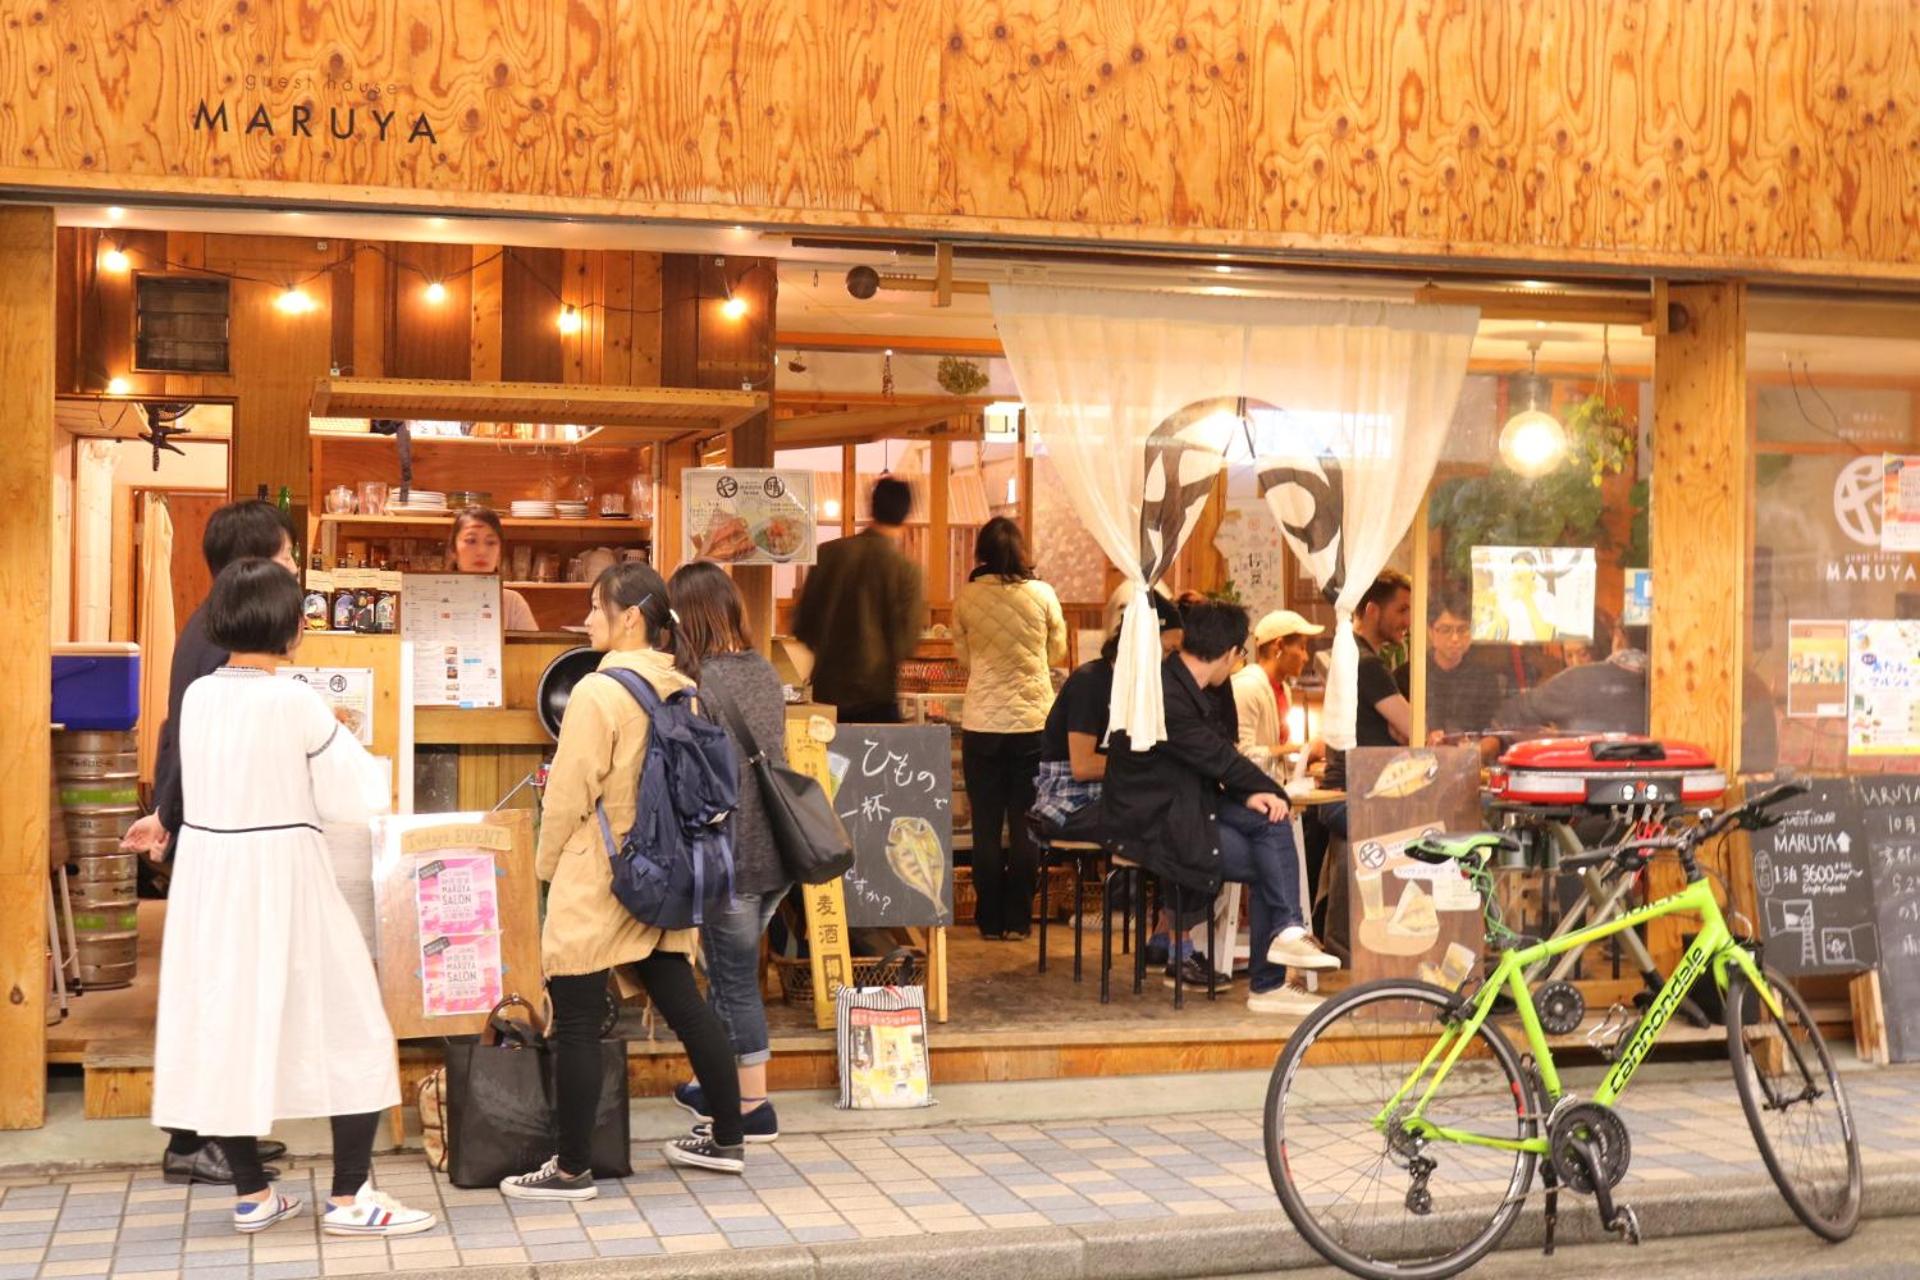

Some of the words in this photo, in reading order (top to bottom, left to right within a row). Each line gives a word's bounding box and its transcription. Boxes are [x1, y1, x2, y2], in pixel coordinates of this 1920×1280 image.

[245, 73, 311, 90] guest
[327, 73, 398, 95] house
[193, 97, 437, 144] MARUYA
[1825, 562, 1917, 582] MARUYA
[840, 794, 892, 822] 一杯
[1774, 833, 1838, 854] MARUYA
[442, 893, 471, 906] SALON
[1610, 946, 1706, 1096] cannondale
